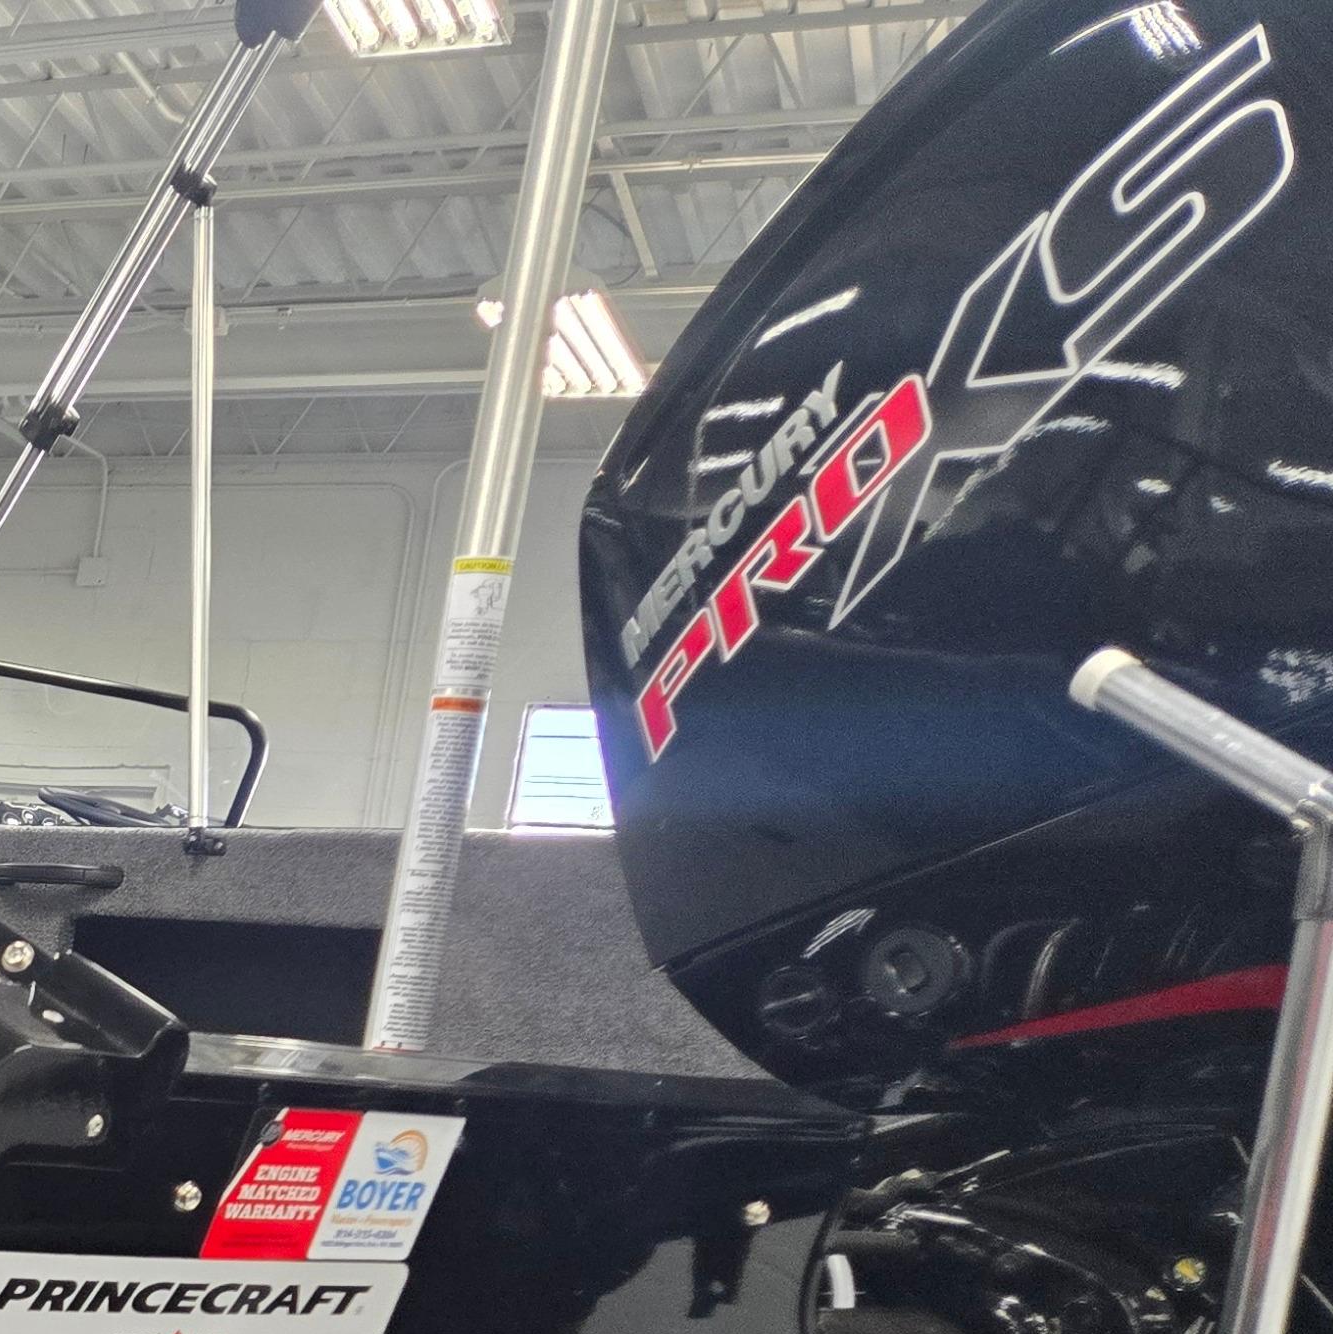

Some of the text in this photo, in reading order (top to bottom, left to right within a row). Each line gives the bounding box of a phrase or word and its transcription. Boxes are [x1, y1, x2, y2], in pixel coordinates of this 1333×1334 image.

[622, 361, 844, 669] MERCURY
[638, 373, 932, 764] PRO
[281, 1128, 345, 1144] MERCURY
[253, 1163, 322, 1183] ENGINE
[236, 1183, 322, 1202] MATCHED
[336, 1178, 428, 1212] BOYER
[223, 1202, 322, 1221] WARRANTY
